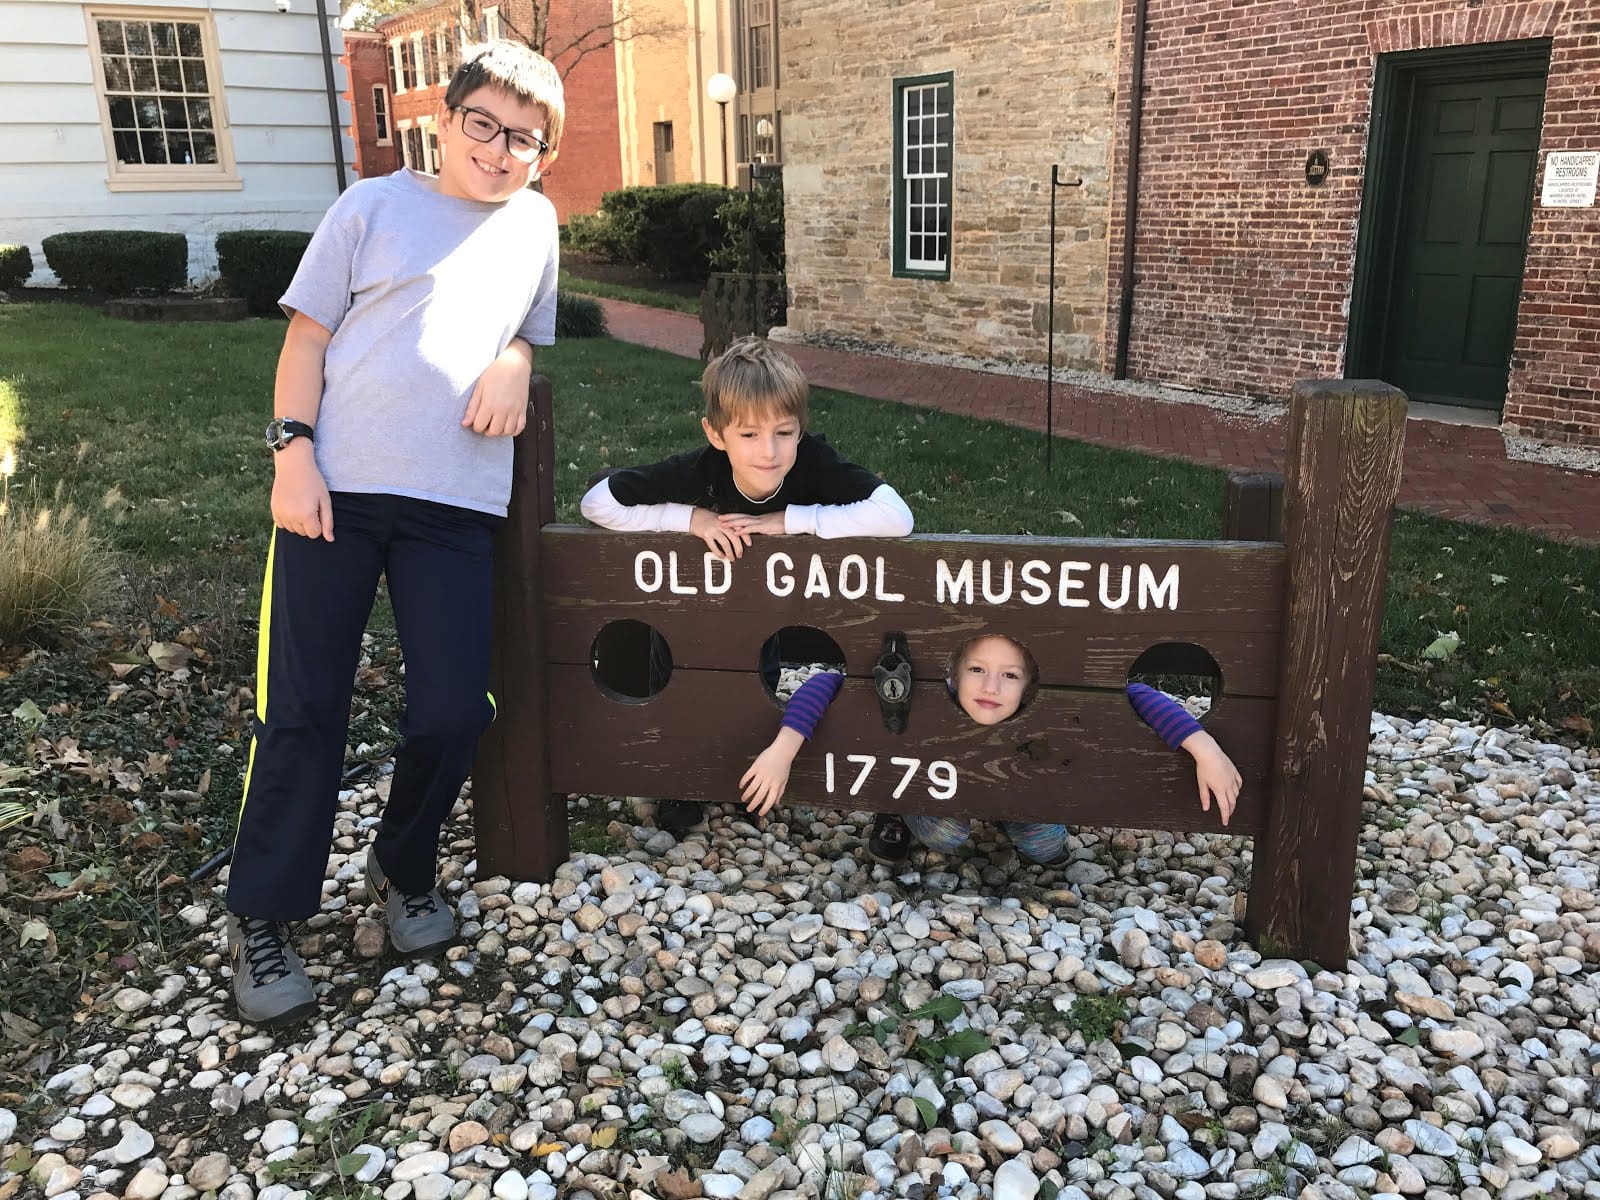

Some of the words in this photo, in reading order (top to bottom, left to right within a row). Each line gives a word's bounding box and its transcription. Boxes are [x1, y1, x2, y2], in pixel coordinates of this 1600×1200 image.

[1551, 156, 1558, 166] NO
[1560, 155, 1595, 166] HANDICAPPED
[1555, 167, 1588, 177] RESTROOMS
[635, 550, 732, 594] OLD
[766, 552, 905, 602] GAOL
[936, 558, 1181, 611] MUSEUM
[825, 752, 959, 800] 1779
